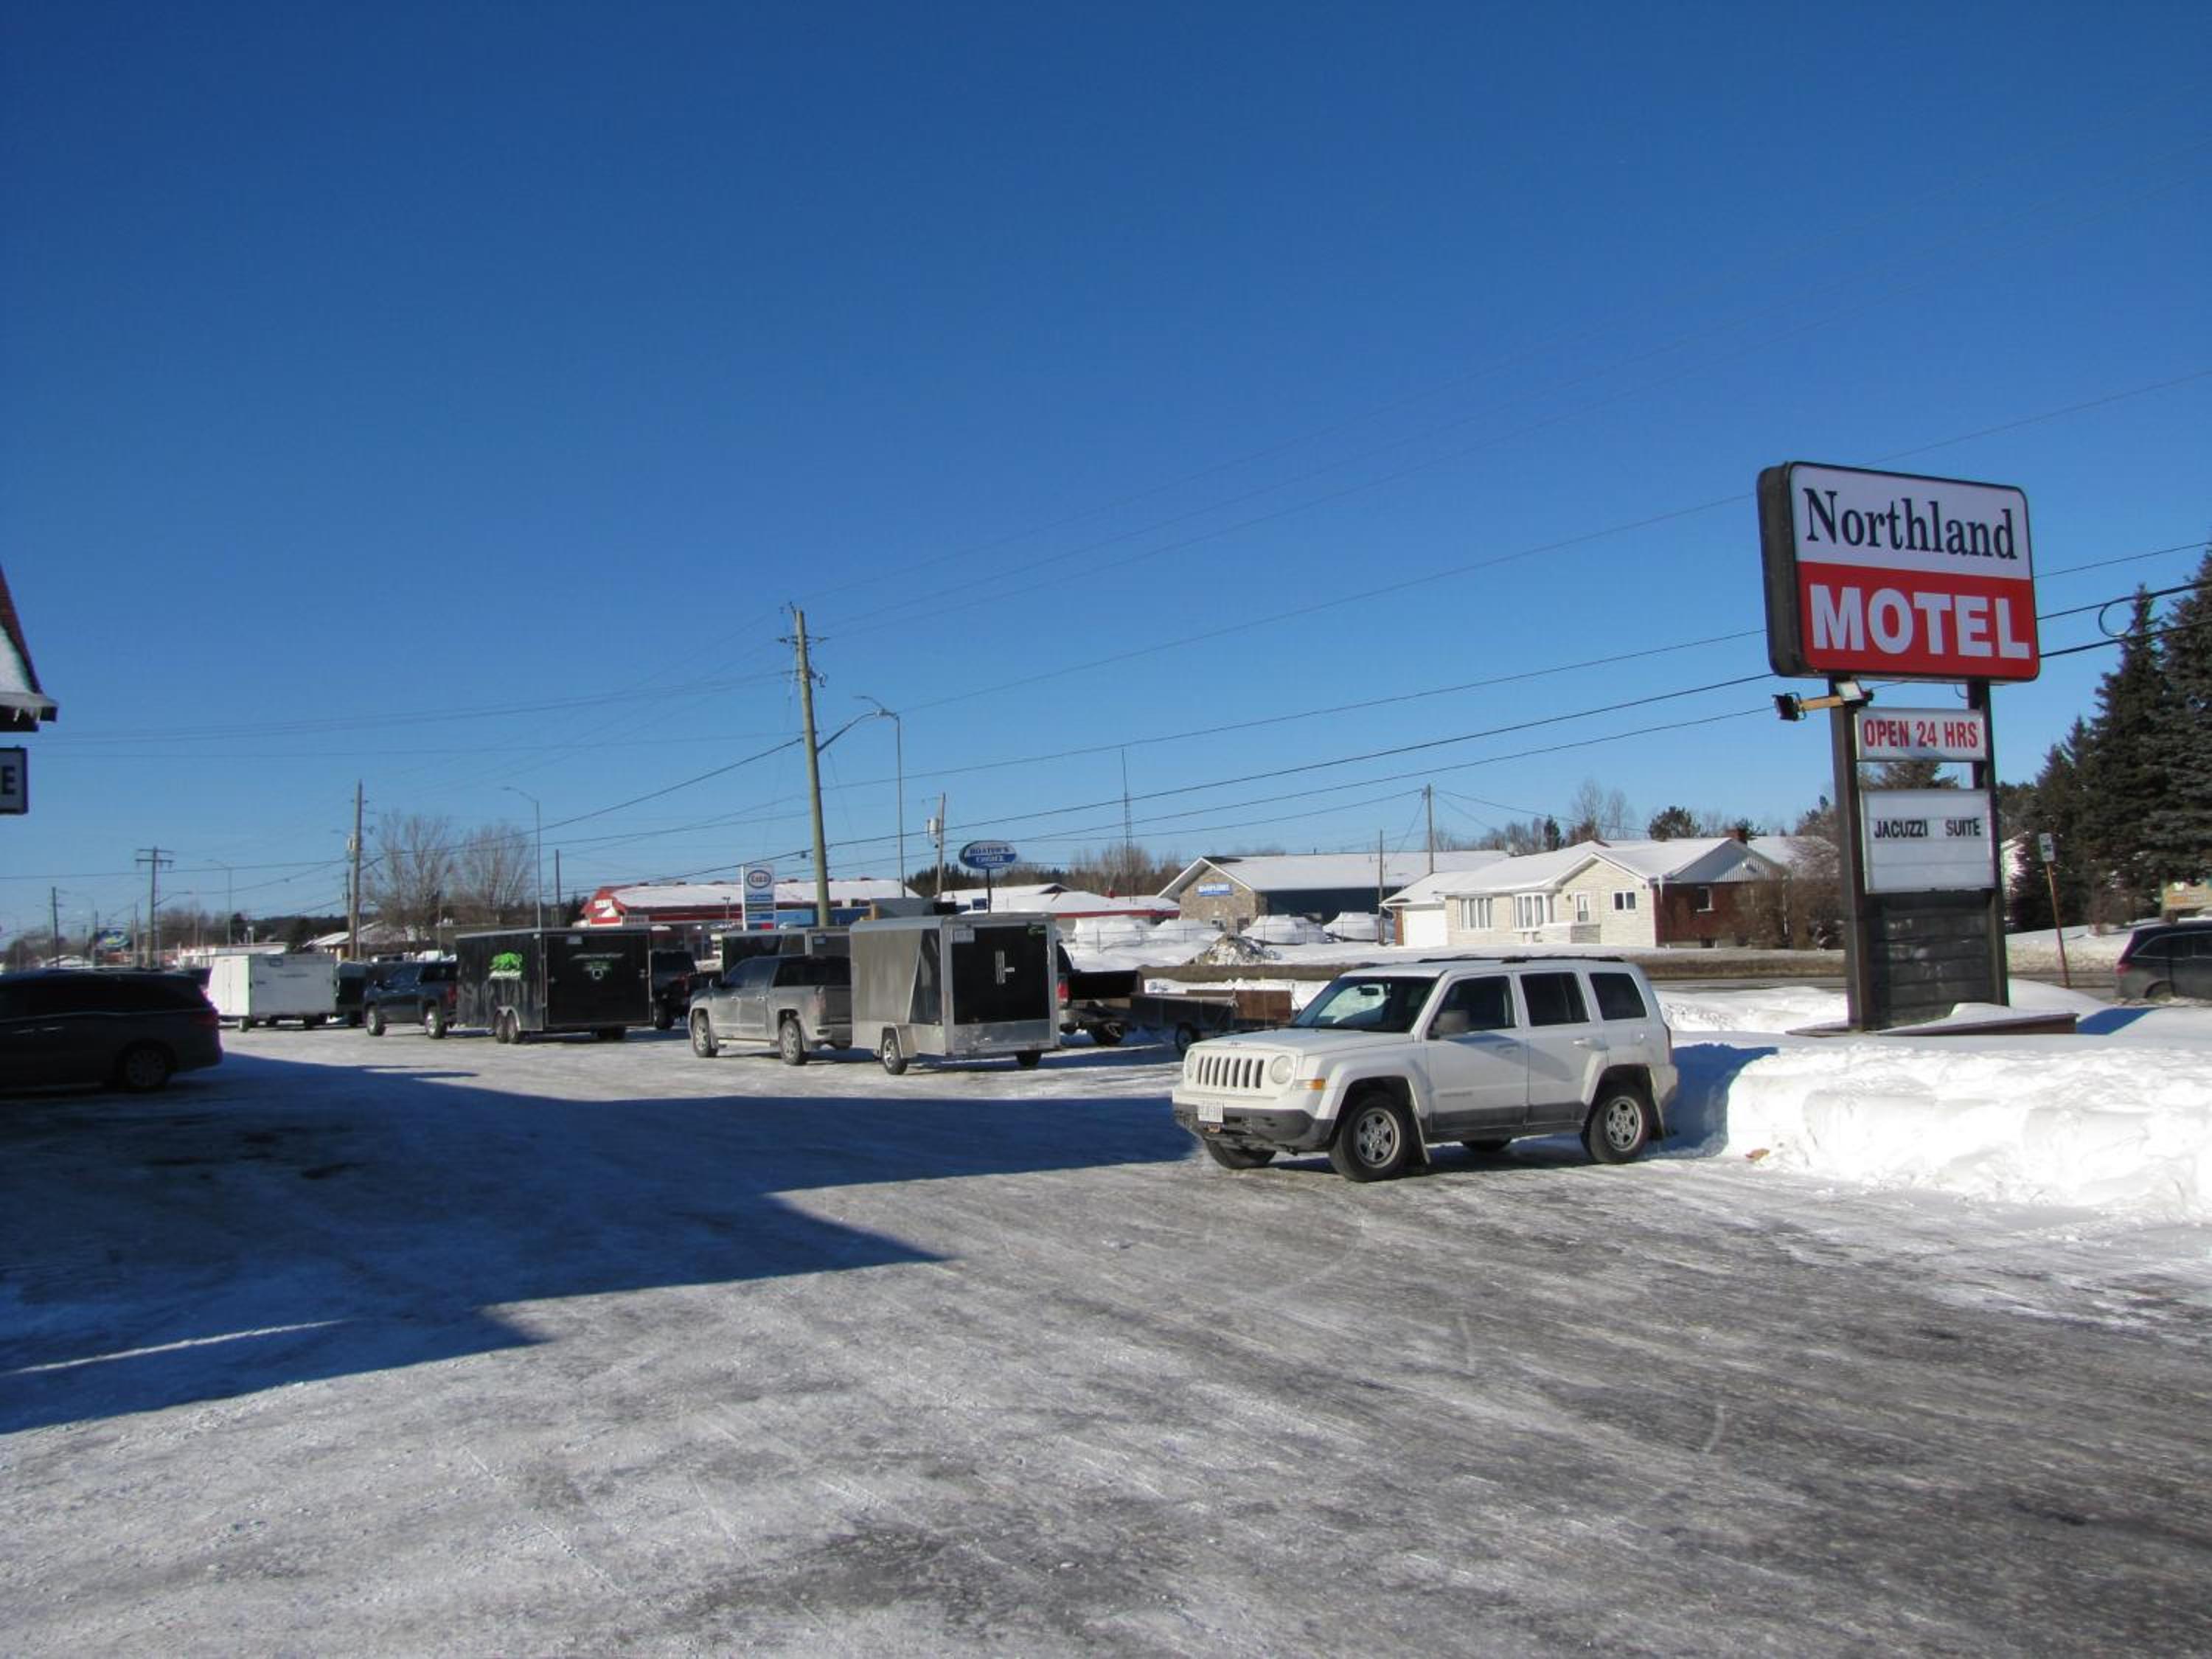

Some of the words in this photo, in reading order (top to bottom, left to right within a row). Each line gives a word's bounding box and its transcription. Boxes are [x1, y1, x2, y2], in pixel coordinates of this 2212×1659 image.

[1803, 487, 2017, 560] Northland
[1809, 584, 2030, 658] MOTEL
[1864, 719, 1910, 747] OPEN
[1916, 720, 1938, 747] 24
[1944, 722, 1978, 748] HRS
[1874, 819, 1928, 838] JACUZZI
[1945, 818, 1981, 837] SUITE
